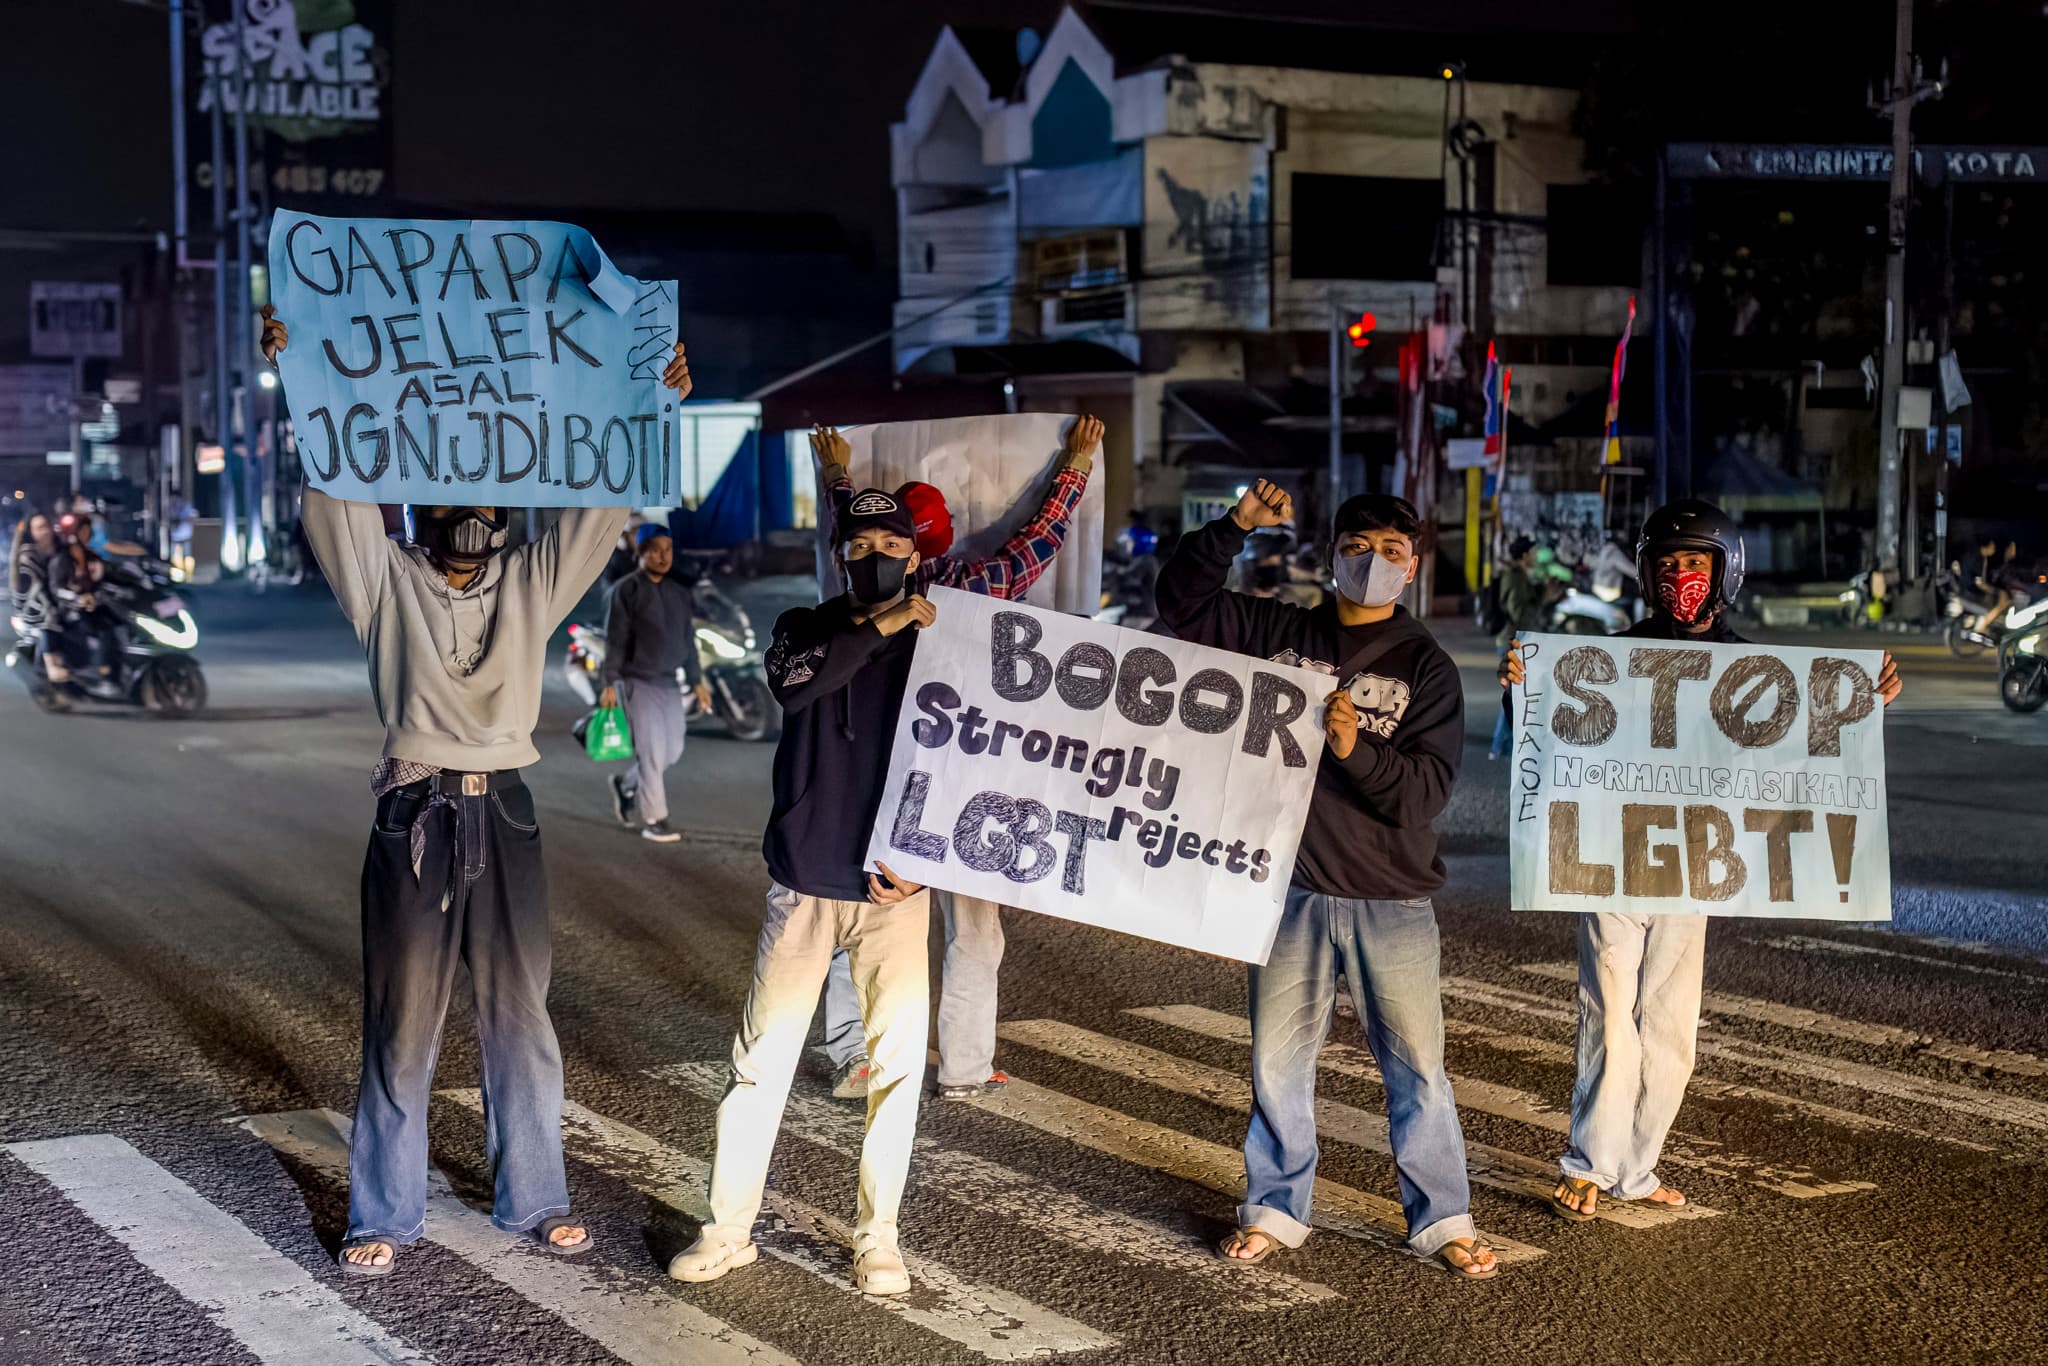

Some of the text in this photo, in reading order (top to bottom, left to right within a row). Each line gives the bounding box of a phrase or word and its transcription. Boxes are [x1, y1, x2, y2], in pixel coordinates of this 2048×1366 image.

[200, 22, 375, 83] SPACE
[1944, 151, 2036, 177] KOTA
[286, 220, 607, 306] GAPAPA
[322, 307, 602, 379] JELEK
[990, 610, 1308, 768] BOGOR
[1517, 642, 1544, 823] PLEASE
[1551, 645, 1876, 758] STOP
[911, 680, 1181, 811] Strongly
[889, 769, 1107, 896] LGBT
[1106, 805, 1272, 883] rejects
